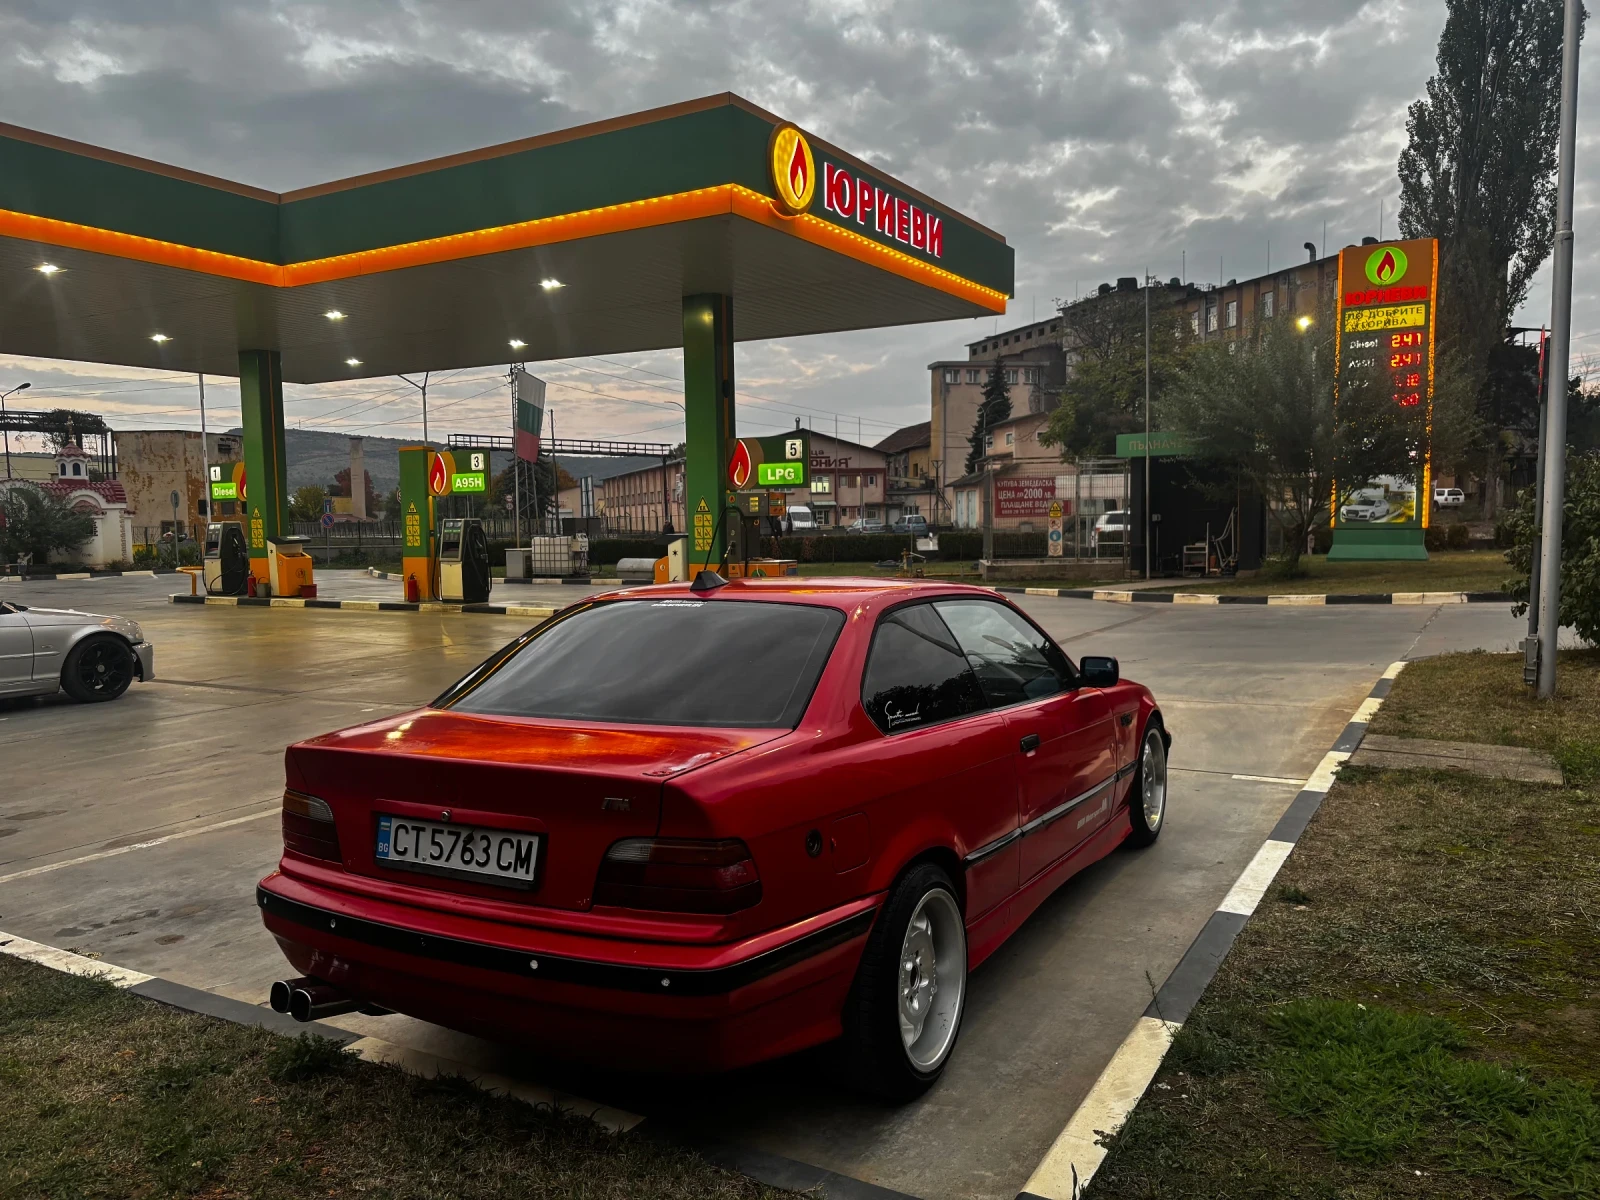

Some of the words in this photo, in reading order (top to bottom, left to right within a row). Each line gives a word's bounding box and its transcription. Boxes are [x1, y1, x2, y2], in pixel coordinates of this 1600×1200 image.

[824, 162, 943, 258] ЮРИЕВИ
[1345, 285, 1427, 306] ЮРИЕВИ
[1391, 332, 1422, 348] 2.41
[790, 442, 798, 457] 5
[474, 456, 480, 468] 3
[767, 467, 795, 481] LPG
[213, 486, 236, 496] Diesel
[998, 490, 1015, 500] ЦЕНА
[1024, 488, 1043, 499] 2000
[1001, 501, 1033, 509] ПЛАЩАНЕ
[378, 842, 389, 853] BG
